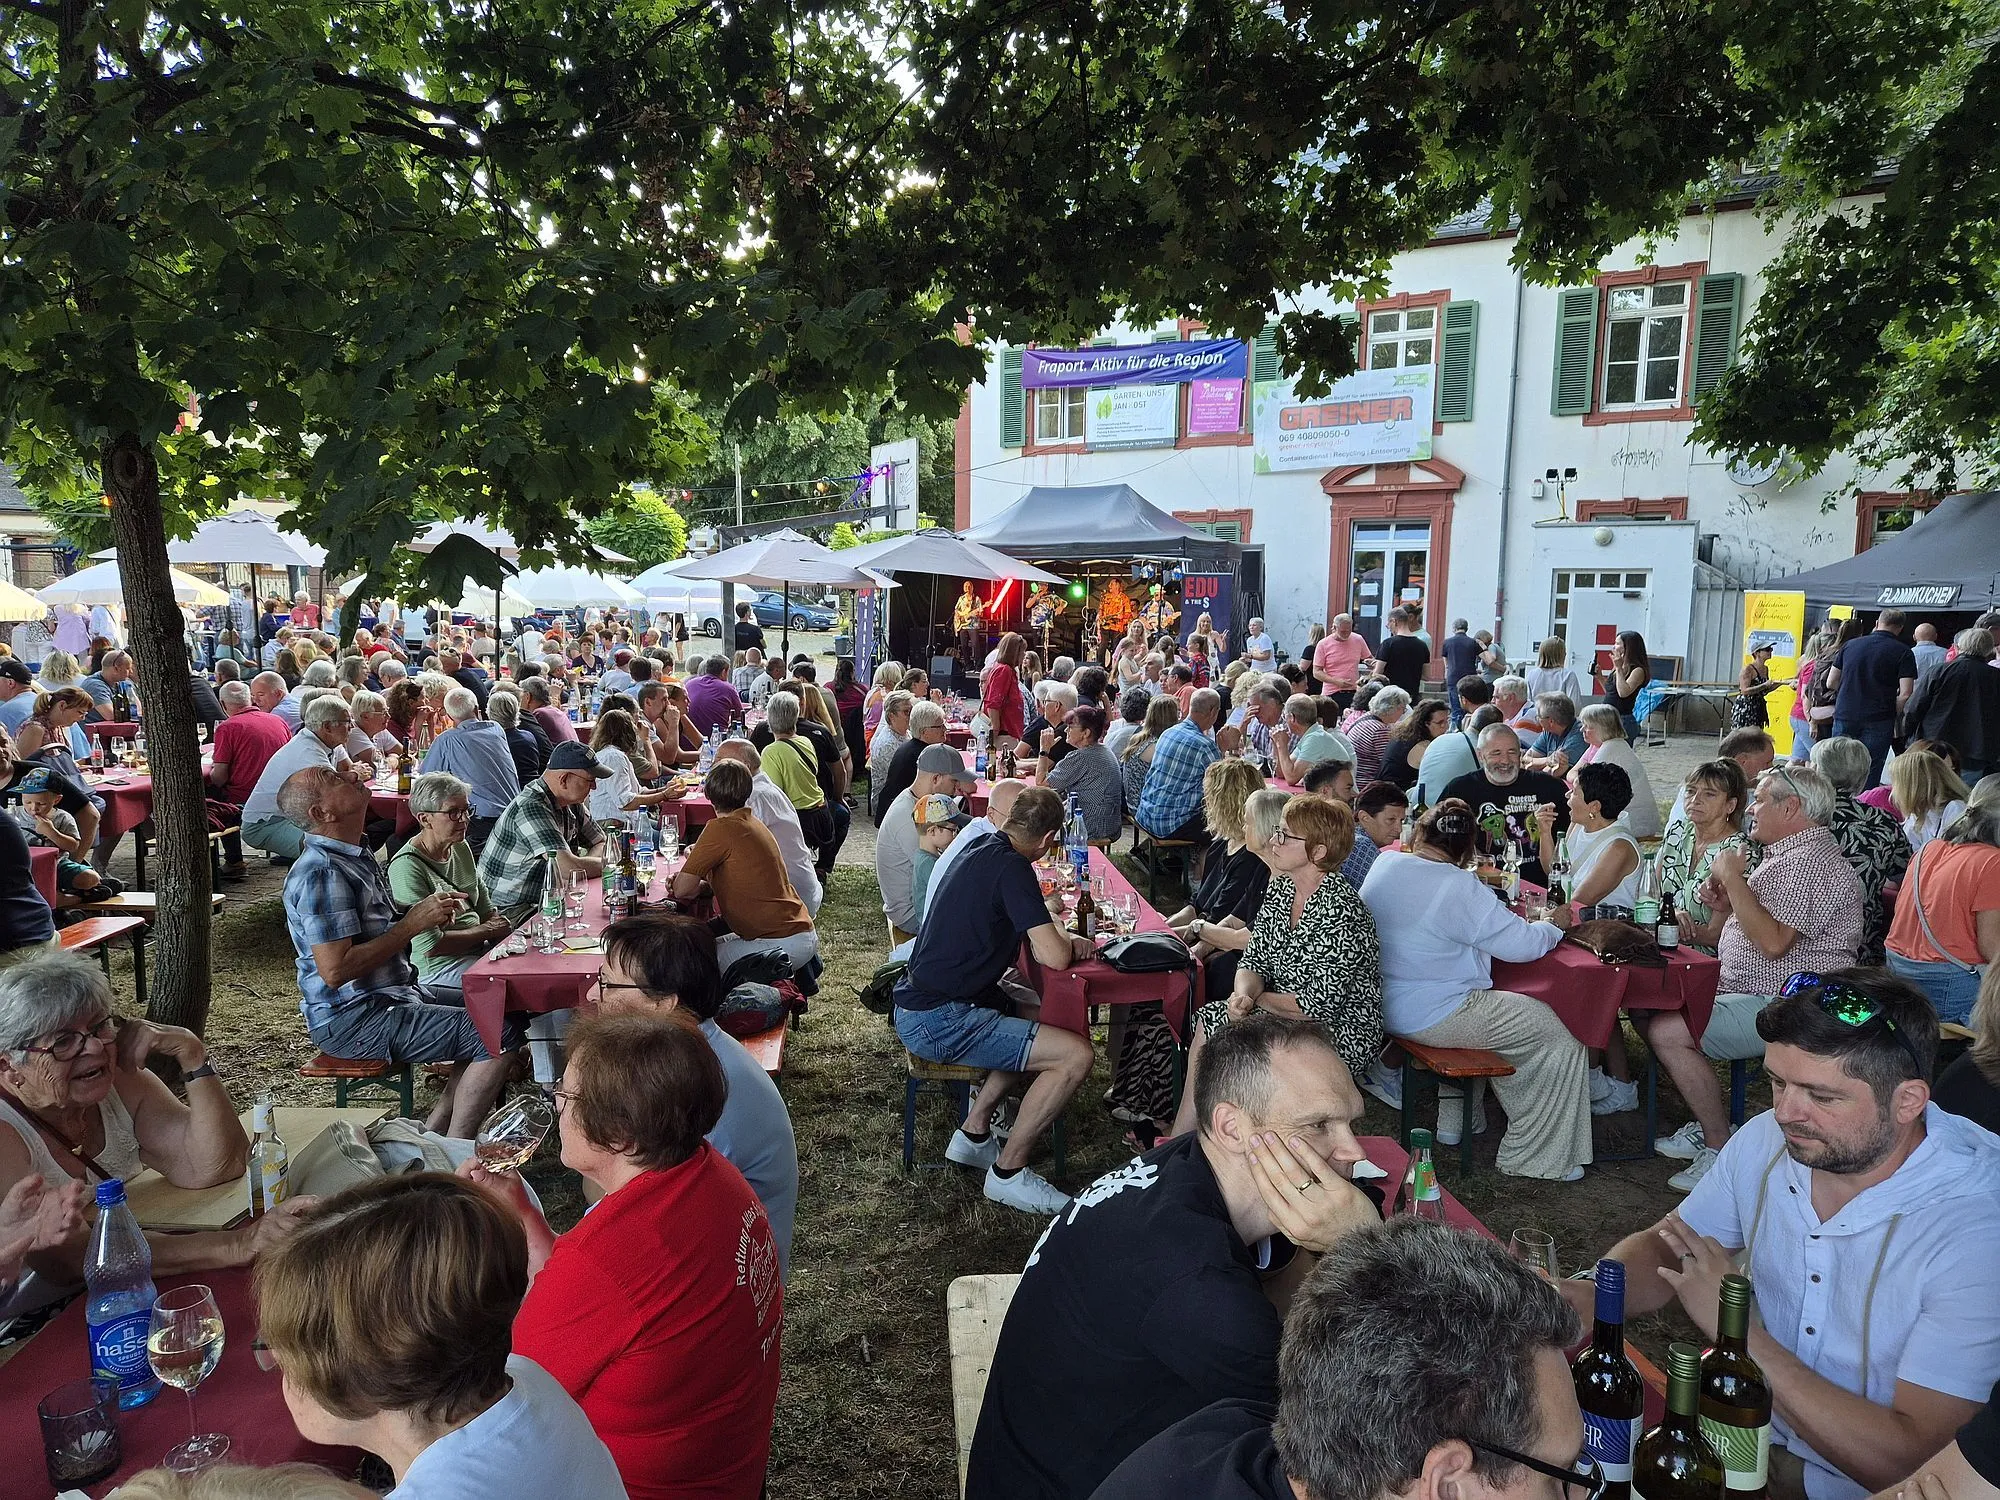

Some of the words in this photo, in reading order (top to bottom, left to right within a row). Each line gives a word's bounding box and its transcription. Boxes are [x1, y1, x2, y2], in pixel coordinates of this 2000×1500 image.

[1038, 359, 1087, 377] Fraport.
[1091, 357, 1124, 371] Aktiv
[1126, 355, 1147, 371] für
[1149, 355, 1171, 369] die
[1175, 351, 1227, 371] Region.
[1114, 401, 1128, 410] JAN
[1279, 396, 1413, 431] GREINER
[1279, 433, 1295, 442] 069
[1297, 430, 1350, 441] 40809050-0
[1279, 453, 1329, 463] Containerdienst
[1333, 450, 1366, 459] Recycling
[1370, 446, 1411, 456] Entsorgung
[1185, 577, 1218, 598] EDU
[1877, 586, 1957, 605] FLAMMKUCHEN
[1508, 794, 1537, 804] Queens
[736, 1228, 751, 1287] Rettung
[95, 1335, 147, 1357] hass
